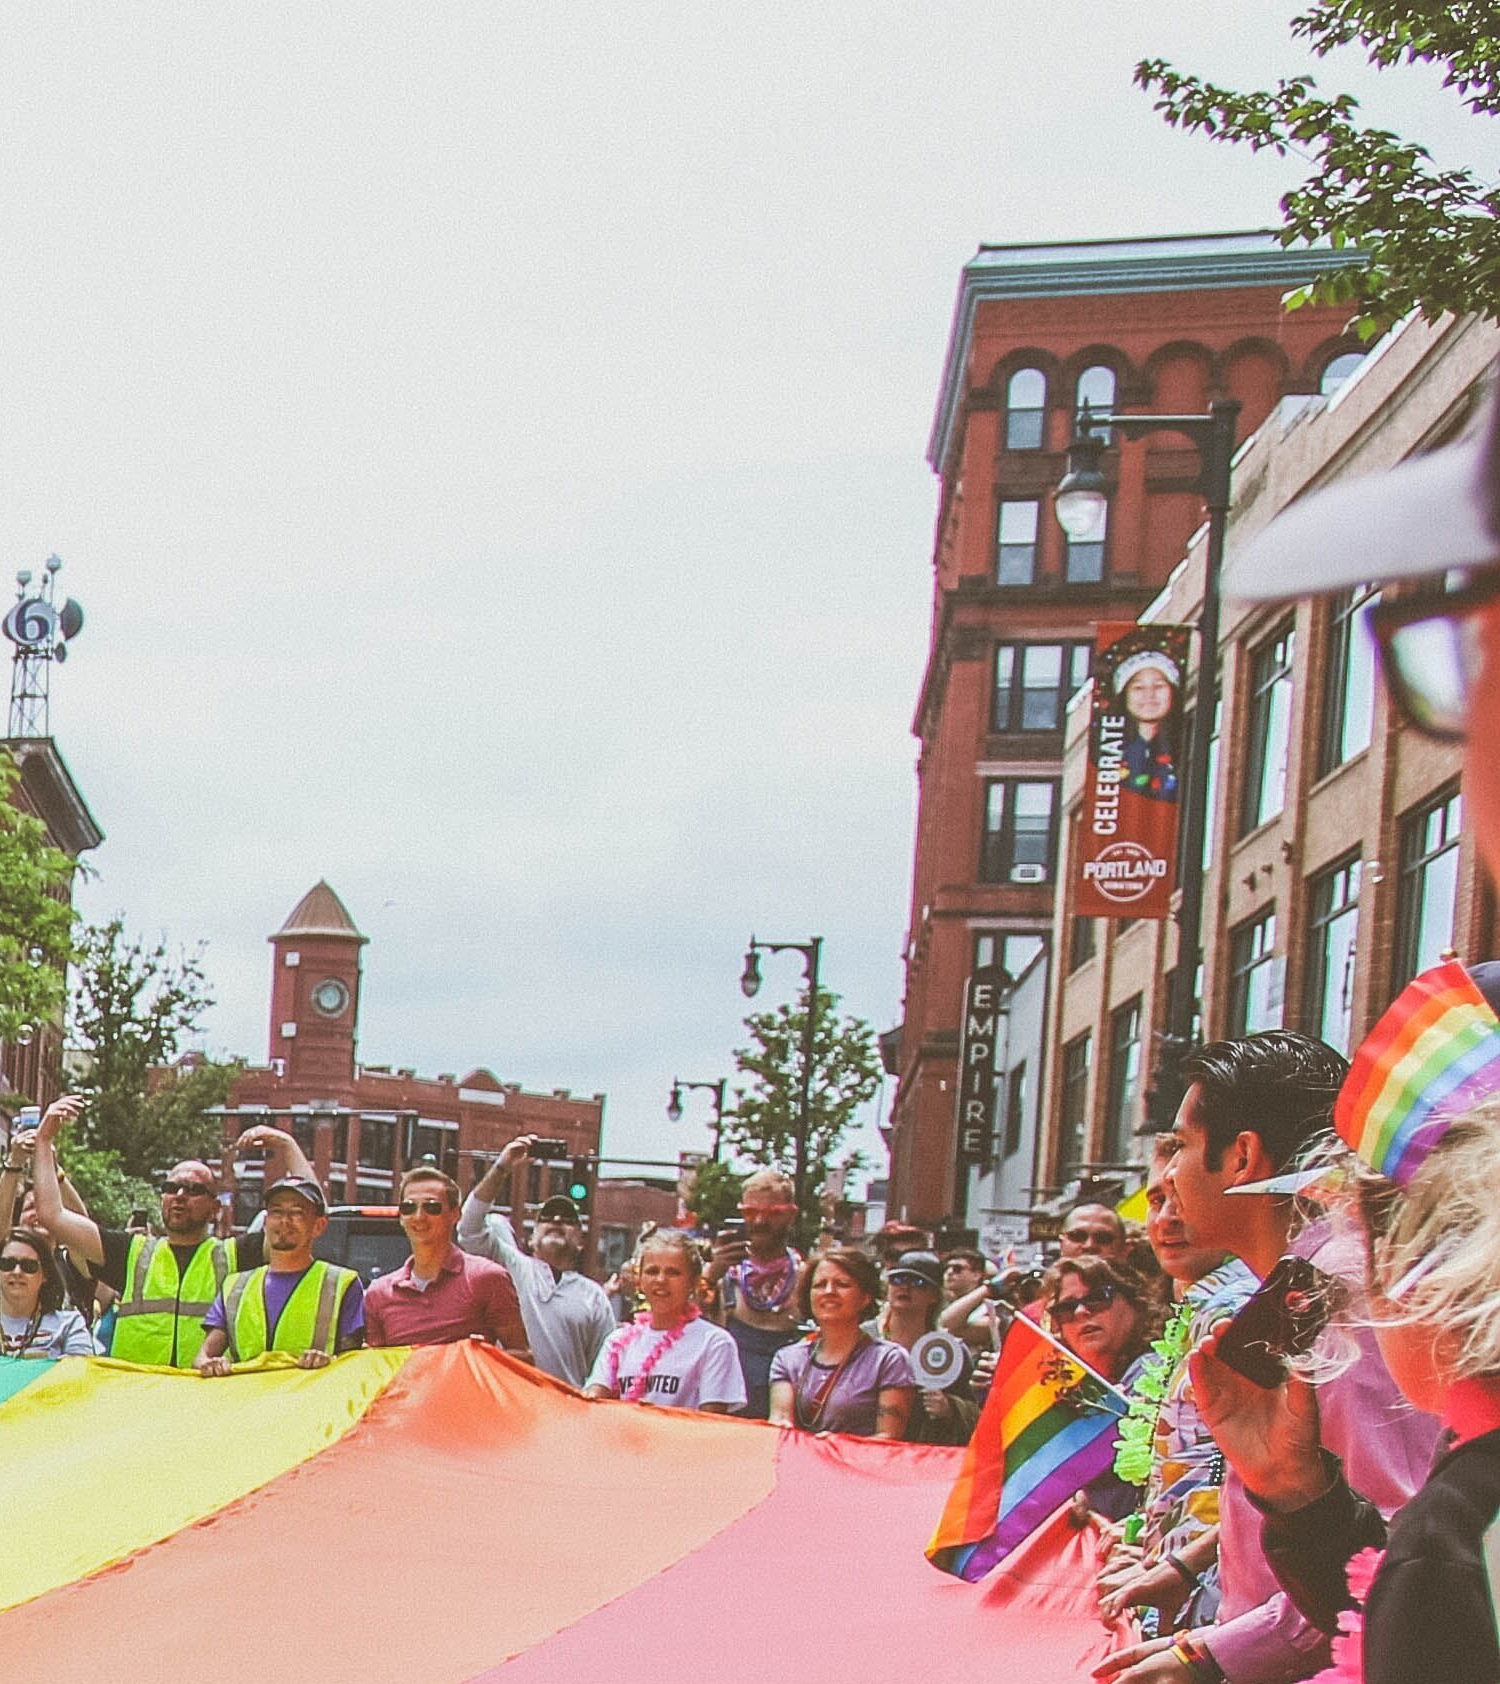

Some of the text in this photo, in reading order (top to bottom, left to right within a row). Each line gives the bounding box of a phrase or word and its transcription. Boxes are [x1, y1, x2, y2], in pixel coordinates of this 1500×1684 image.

[15, 598, 50, 641] 6
[1093, 715, 1125, 835] CELEBRATE
[1083, 859, 1166, 880] PORTLAND
[964, 984, 994, 1152] EMPIRE
